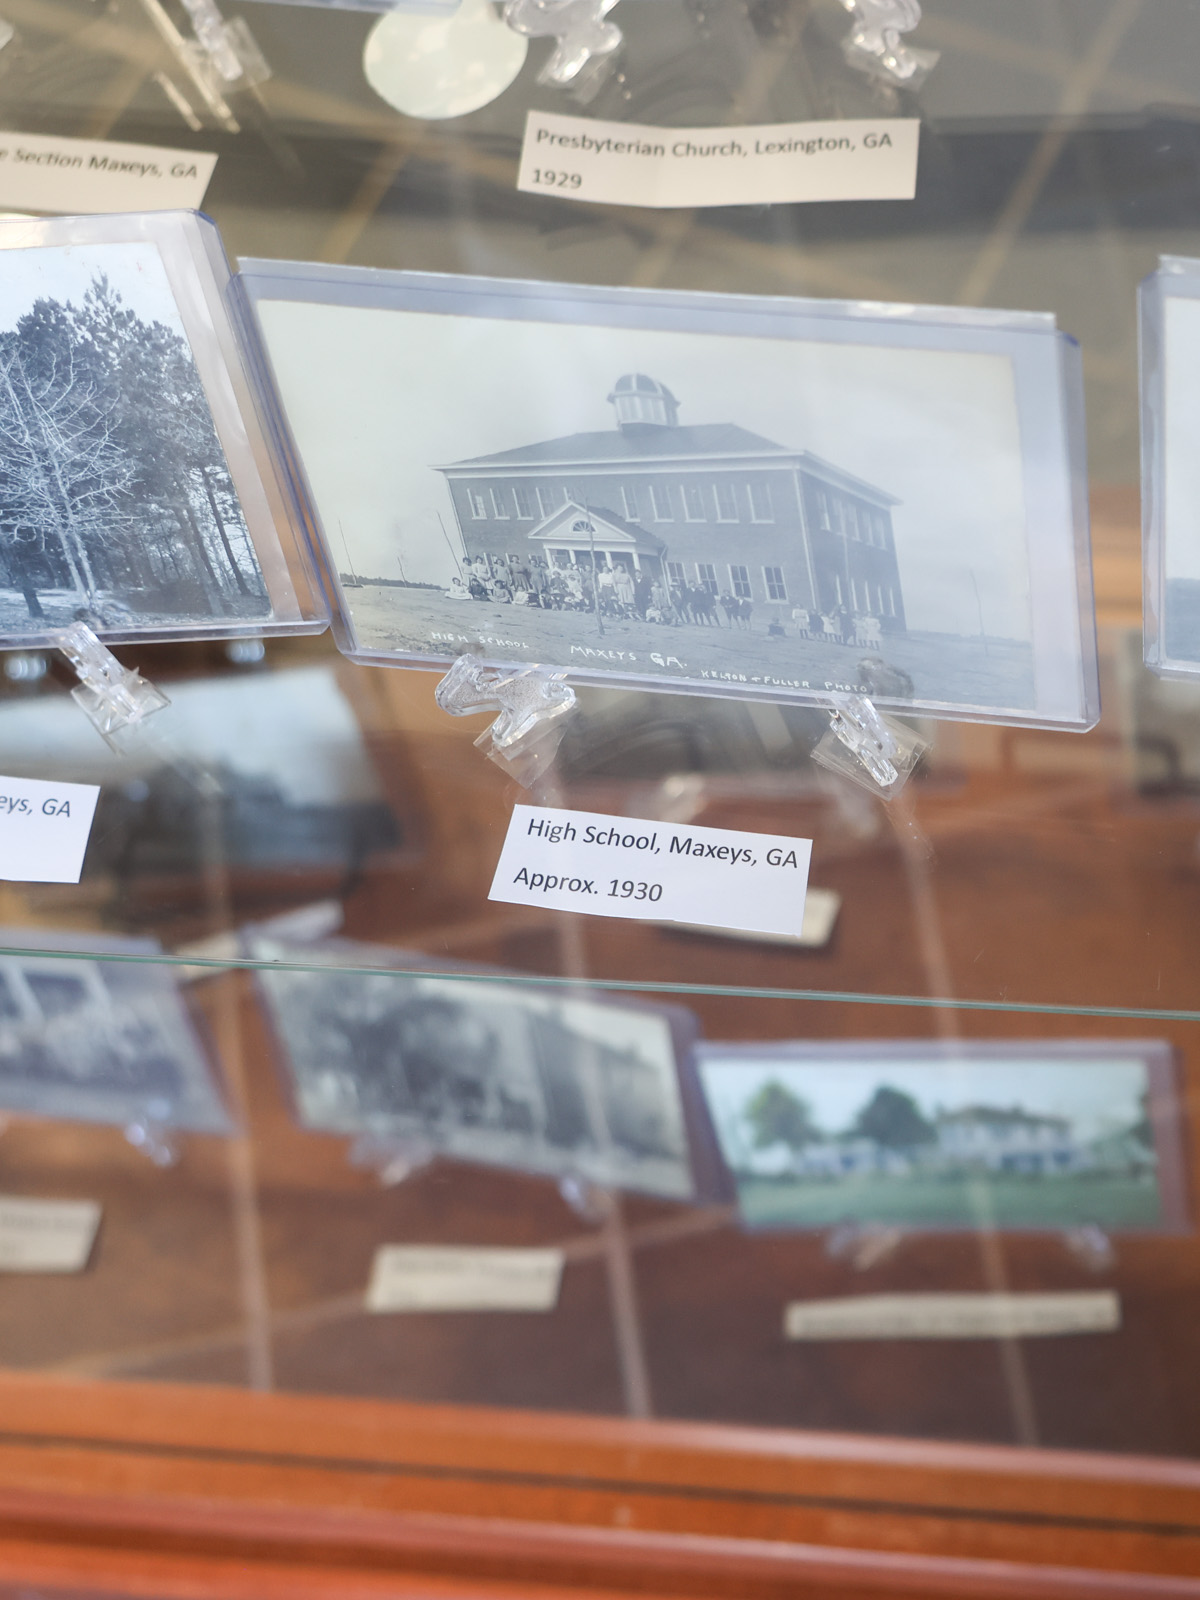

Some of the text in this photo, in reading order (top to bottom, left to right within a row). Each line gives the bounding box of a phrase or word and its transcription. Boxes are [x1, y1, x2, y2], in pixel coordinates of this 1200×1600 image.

[536, 128, 892, 157] Presbyterian Church, Lexington, GA
[13, 150, 83, 168] Section
[89, 155, 163, 178] Maxeys,
[170, 164, 198, 178] GA
[532, 169, 582, 189] 1929
[431, 632, 530, 649] HIGH SCHOOL
[570, 645, 688, 668] MAXEYS GA.
[701, 670, 746, 682] KELTON
[764, 676, 810, 688] FULLER
[824, 682, 867, 693] PHOTO
[42, 798, 70, 818] GA
[527, 818, 798, 869] High School, Maxeys, GA
[513, 867, 663, 902] Approx. 1930
